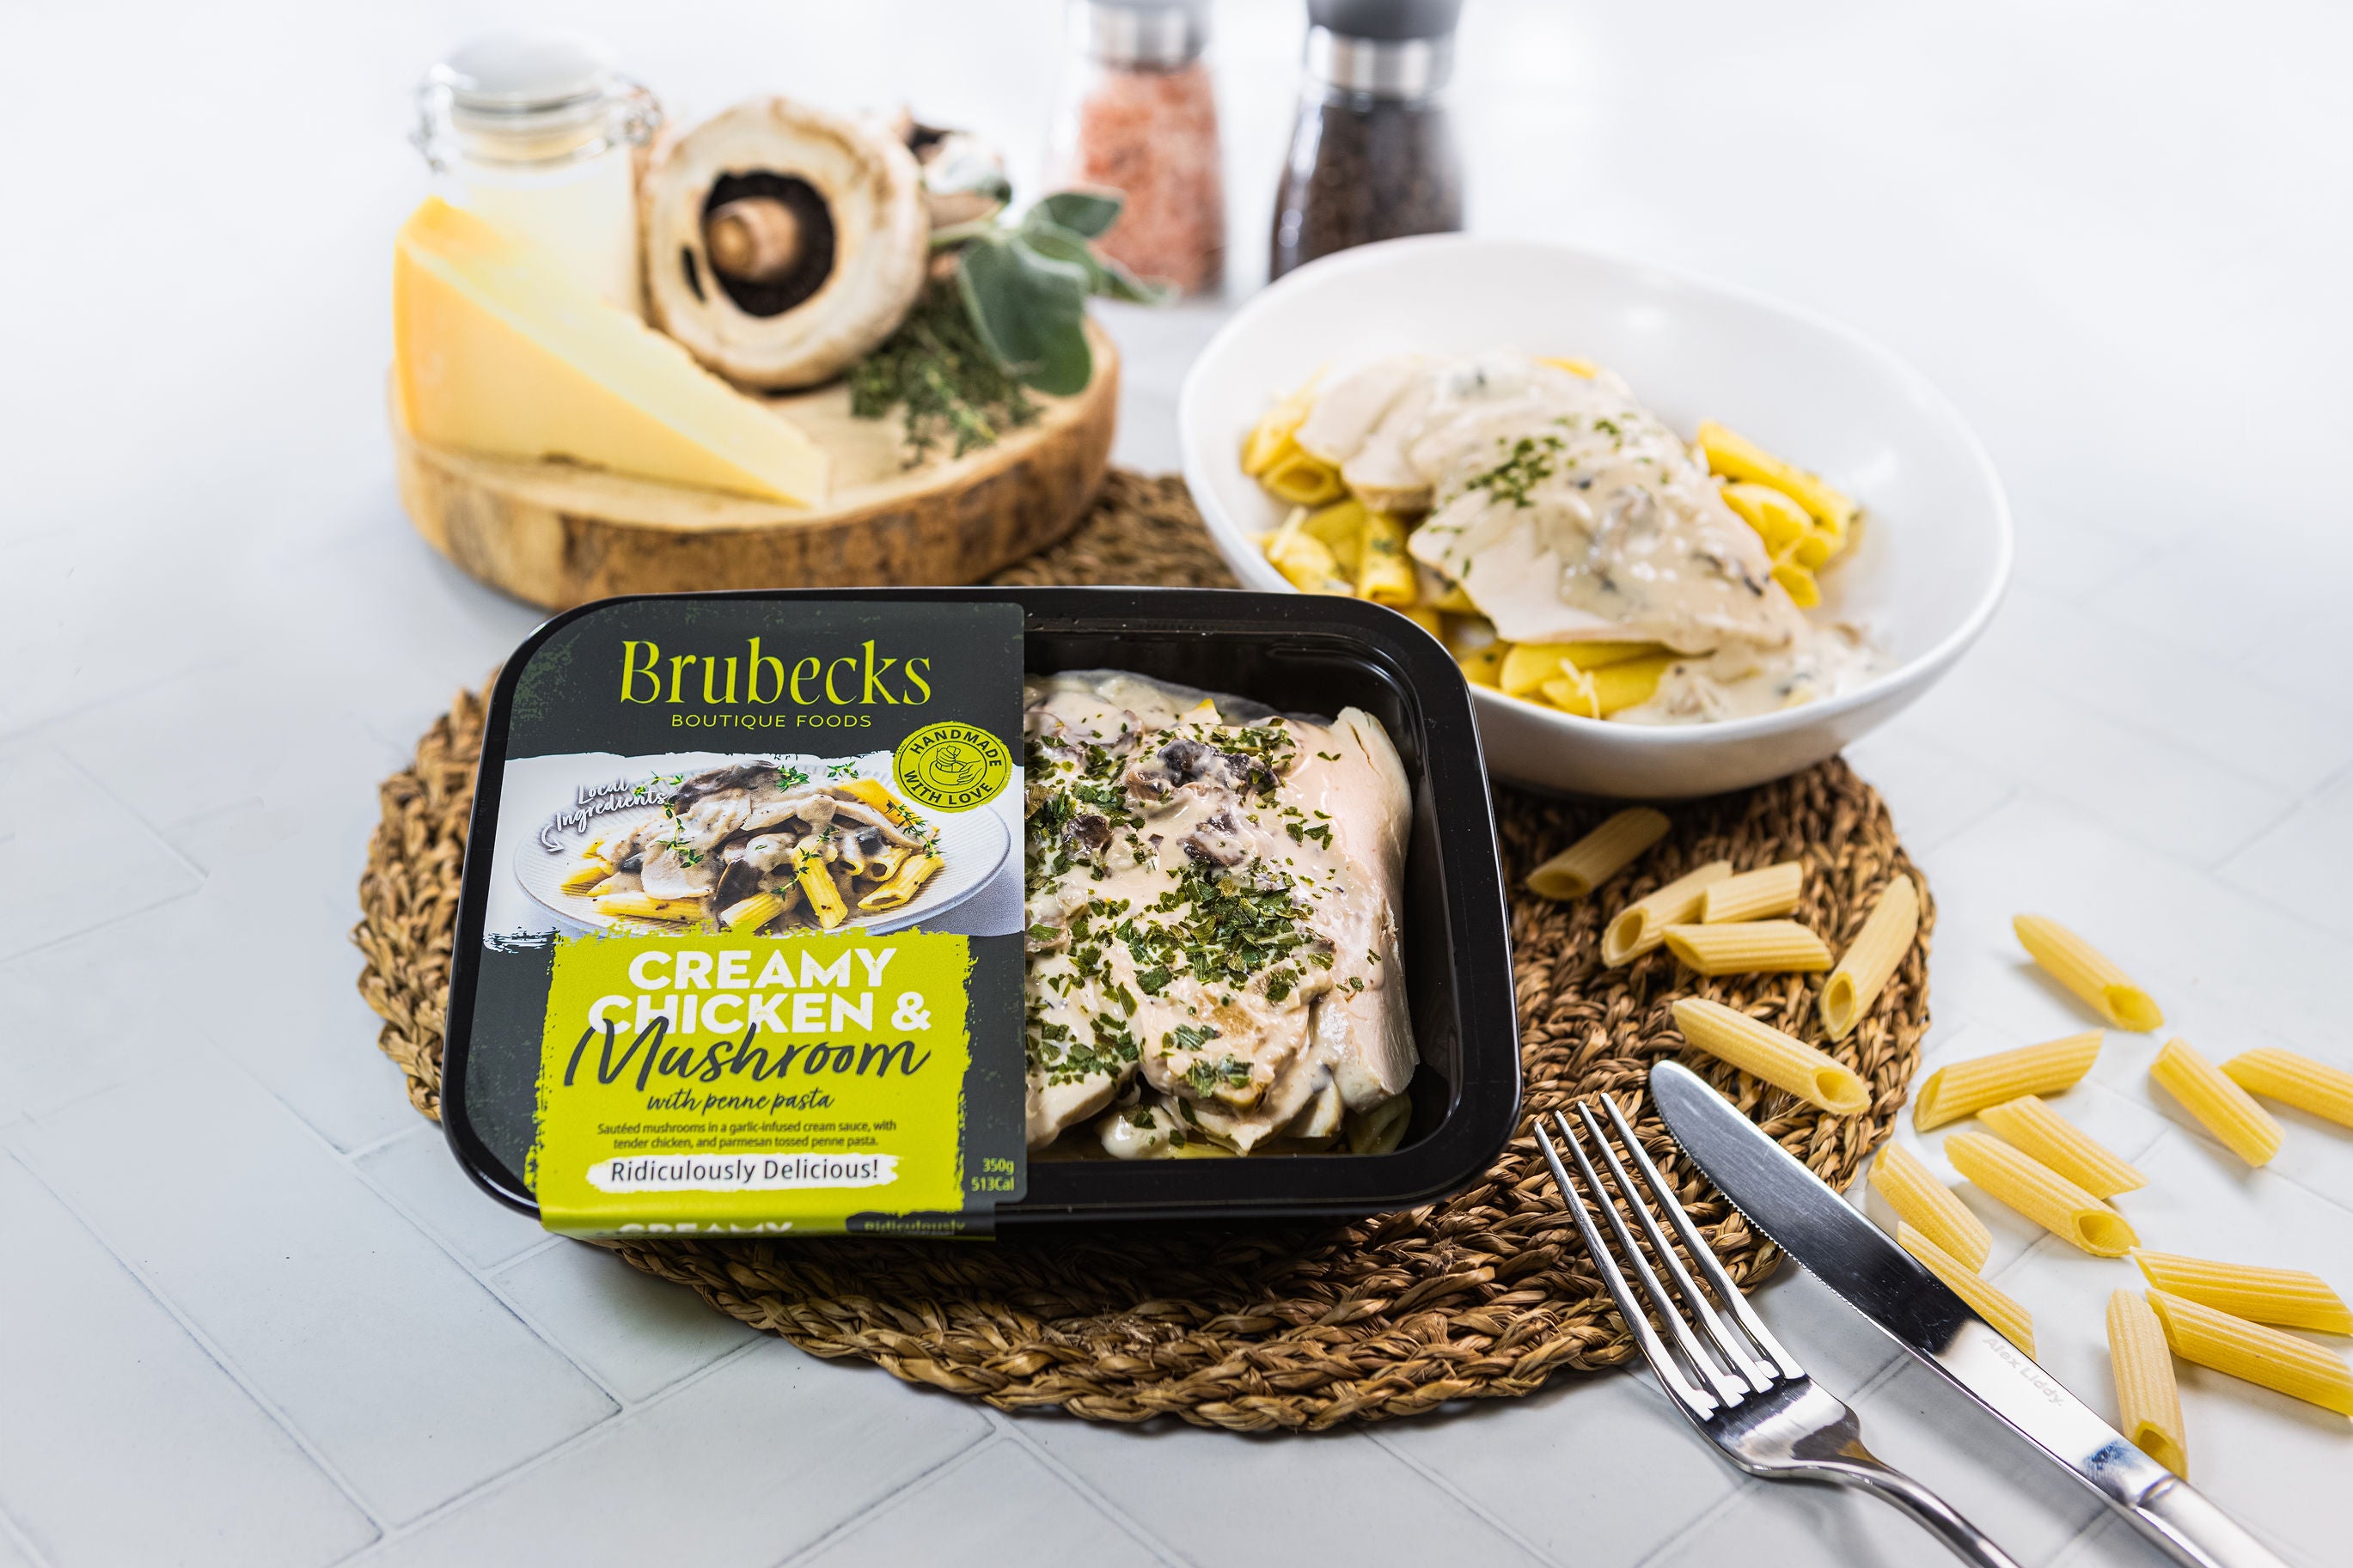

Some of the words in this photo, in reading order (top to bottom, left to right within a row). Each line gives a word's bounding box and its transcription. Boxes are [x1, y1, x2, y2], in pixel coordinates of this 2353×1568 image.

[620, 636, 932, 705] Brubecks
[671, 714, 785, 729] BOUTIQUE
[797, 714, 871, 728] FOODS
[909, 729, 1002, 767] HANDMADE
[578, 777, 630, 804] Local
[903, 770, 942, 803] WITH
[948, 783, 993, 805] LOVE
[555, 790, 668, 833] Ingredients
[628, 948, 897, 991] CREAMY
[588, 992, 873, 1035] CHICKEN
[891, 991, 932, 1032] &
[564, 1015, 931, 1091] Mushroom
[646, 1089, 701, 1111] with
[700, 1091, 769, 1115] penne
[770, 1087, 835, 1115] pasta
[597, 1123, 640, 1135] Sautéed
[643, 1122, 706, 1134] mushrooms
[707, 1121, 718, 1132] in
[720, 1124, 727, 1132] a
[730, 1120, 801, 1135] garlic-infused
[804, 1122, 836, 1132] cream
[838, 1121, 871, 1133] sauce,
[873, 1120, 896, 1132] with
[614, 1138, 650, 1149] tender
[651, 1137, 694, 1149] chicken,
[696, 1137, 717, 1148] and
[718, 1137, 772, 1150] parmesan
[774, 1137, 809, 1147] tossed
[811, 1137, 844, 1150] penne
[846, 1136, 878, 1150] pasta.
[611, 1159, 755, 1184] Ridiculously
[764, 1158, 878, 1180] Delicious!
[982, 1158, 1015, 1175] 350g
[971, 1176, 1015, 1192] 513Cal
[1981, 1337, 2022, 1370] Alex
